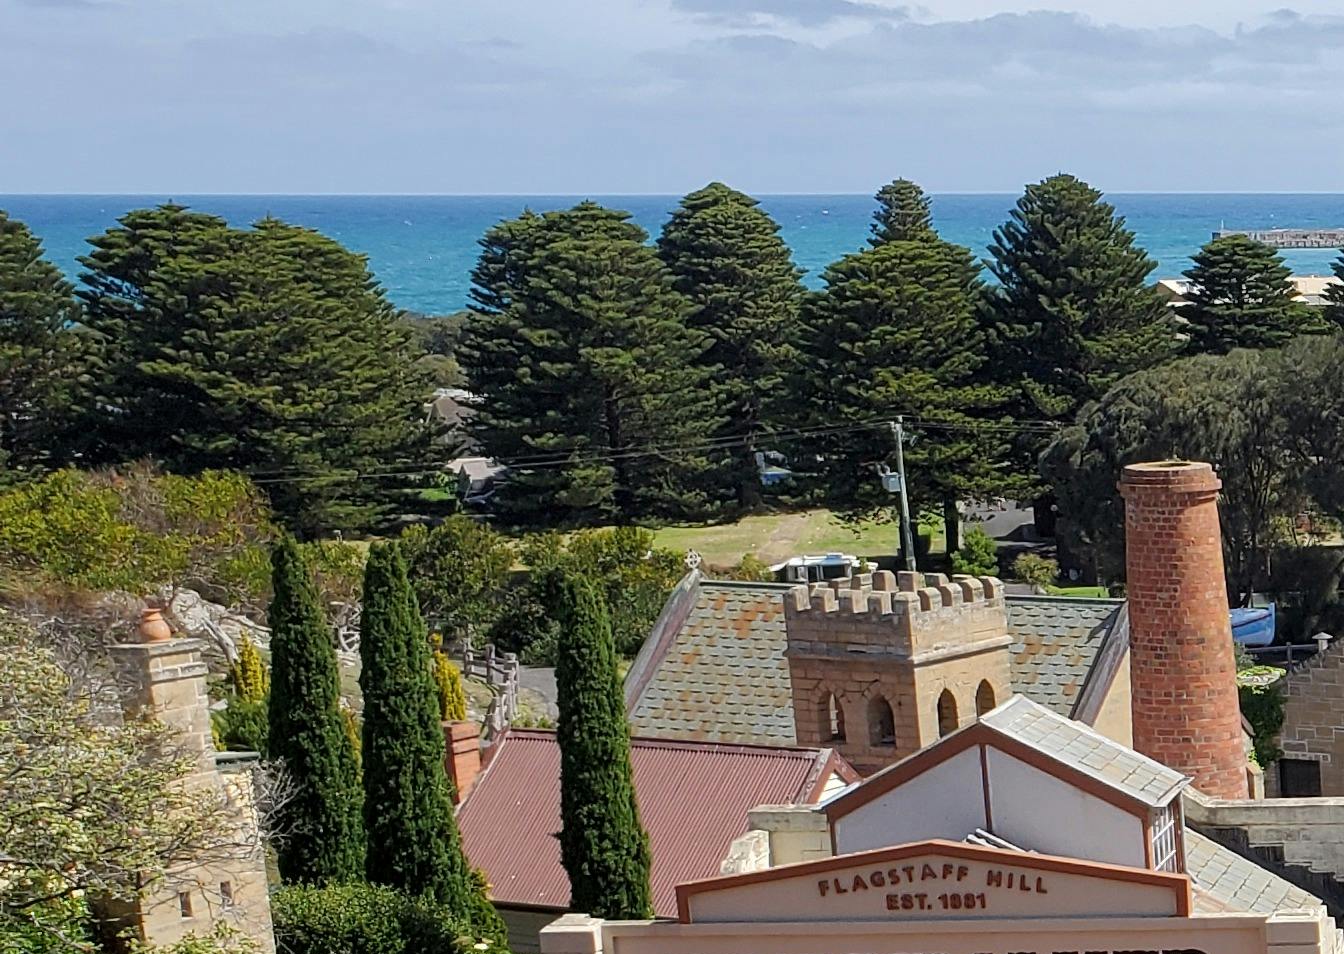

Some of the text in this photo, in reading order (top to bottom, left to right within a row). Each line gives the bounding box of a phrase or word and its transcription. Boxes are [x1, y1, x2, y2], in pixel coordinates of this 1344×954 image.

[817, 863, 1048, 897] FLAGSTAFF HILL
[886, 894, 932, 910] EST.
